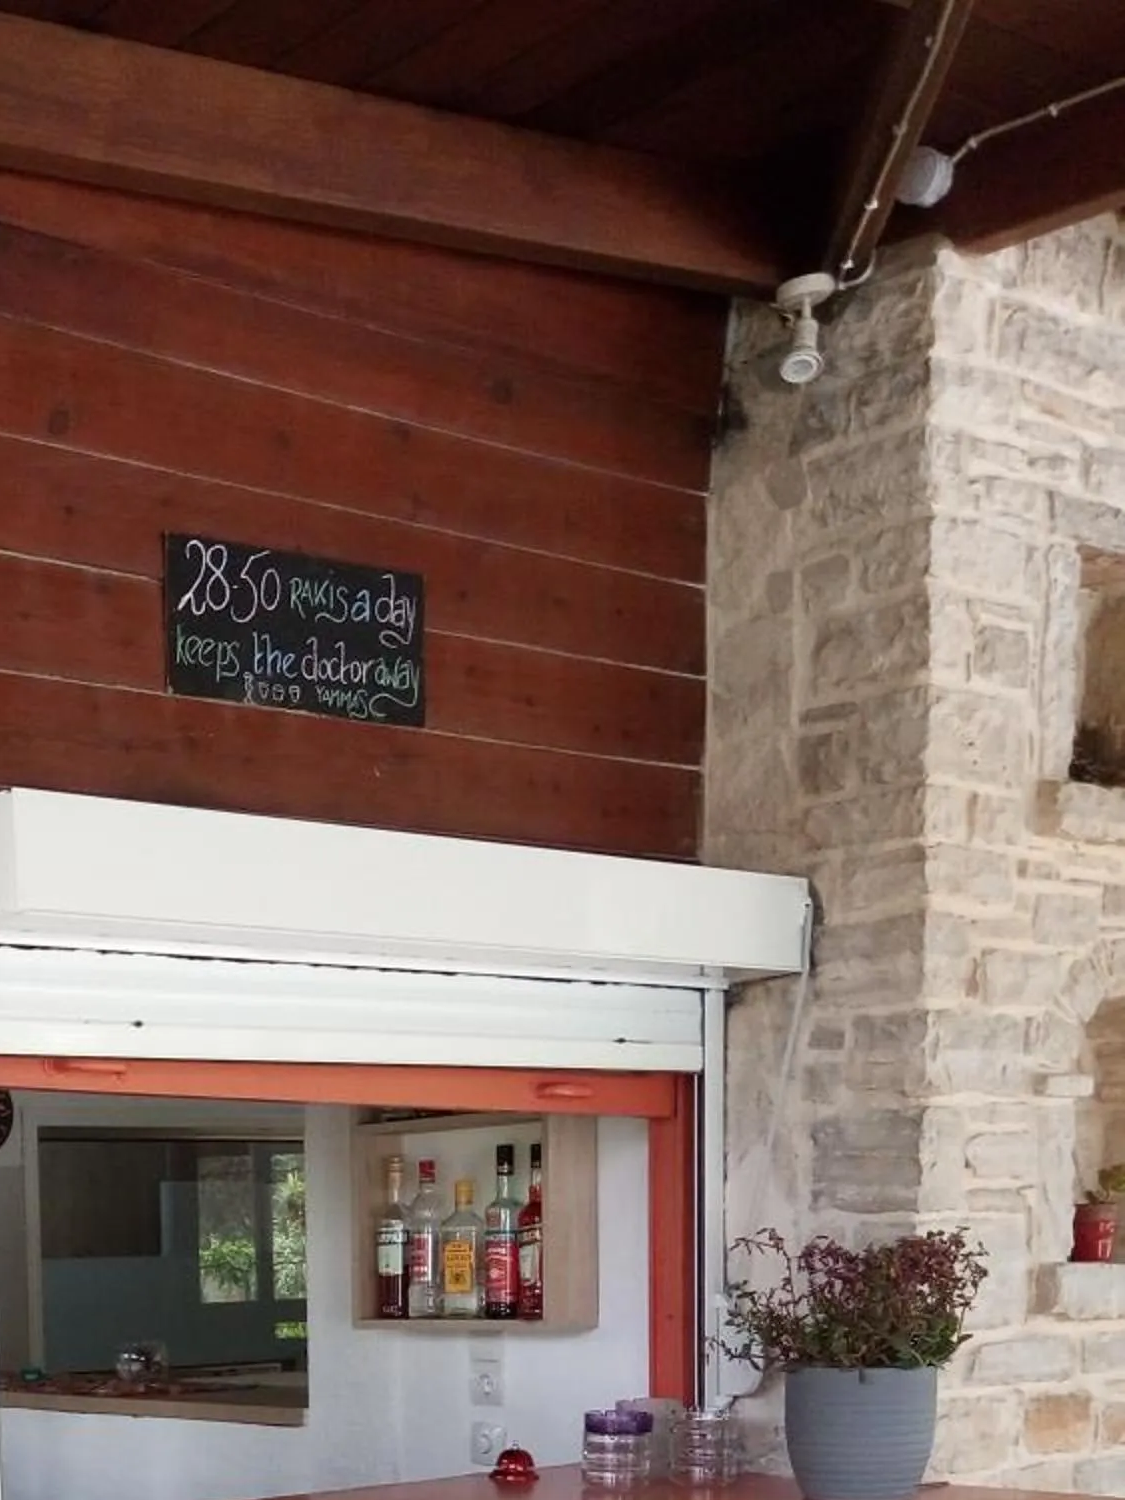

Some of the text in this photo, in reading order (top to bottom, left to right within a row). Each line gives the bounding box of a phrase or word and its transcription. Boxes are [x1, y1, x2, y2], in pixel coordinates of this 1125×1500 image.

[351, 590, 370, 622] a
[374, 574, 417, 648] day
[176, 625, 419, 717] keeps the doctor away
